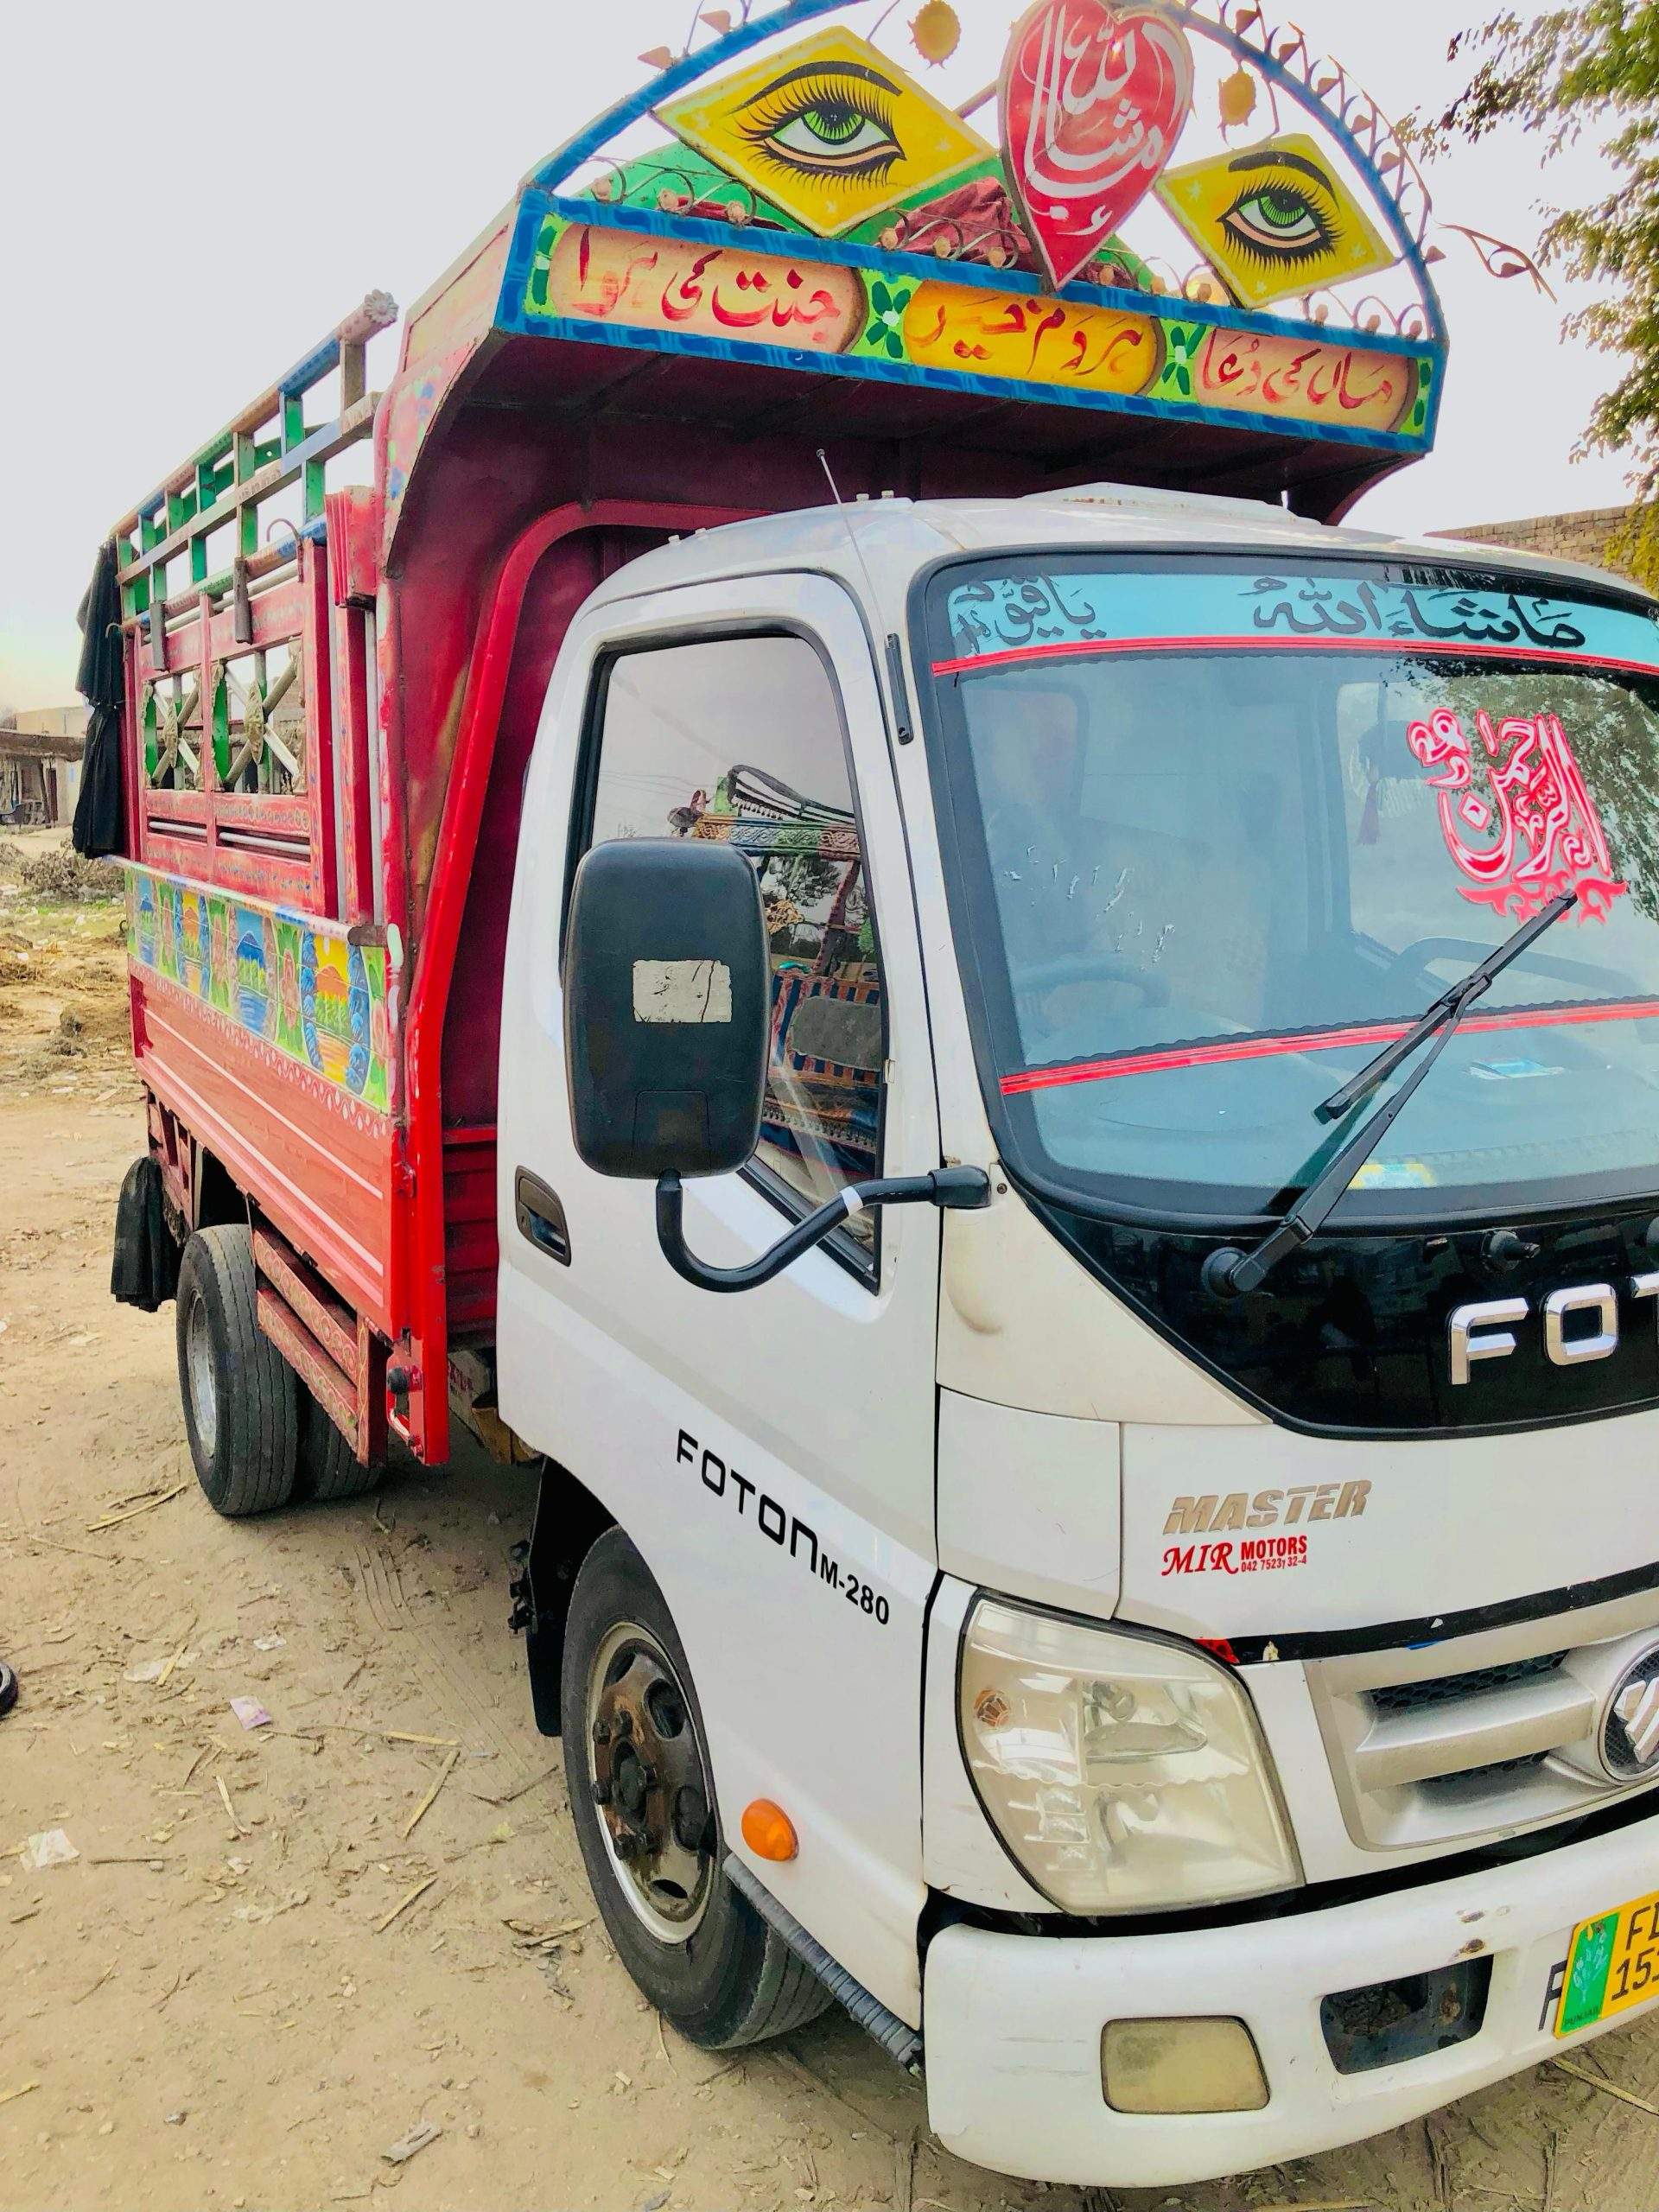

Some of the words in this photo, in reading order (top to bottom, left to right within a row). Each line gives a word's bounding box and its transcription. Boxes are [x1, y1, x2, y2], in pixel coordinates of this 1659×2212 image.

[660, 248, 724, 322] کی
[711, 267, 842, 344] جنت
[1261, 347, 1323, 405] کی
[1306, 351, 1394, 410] ماں
[677, 1428, 819, 1574] FOTON
[820, 1553, 890, 1625] M-280
[1162, 1478, 1373, 1536] MASTER
[1160, 1541, 1239, 1577] MIR
[1241, 1535, 1308, 1560] MOTORS
[1241, 1560, 1258, 1573] 042
[1611, 1946, 1659, 2001] 15
